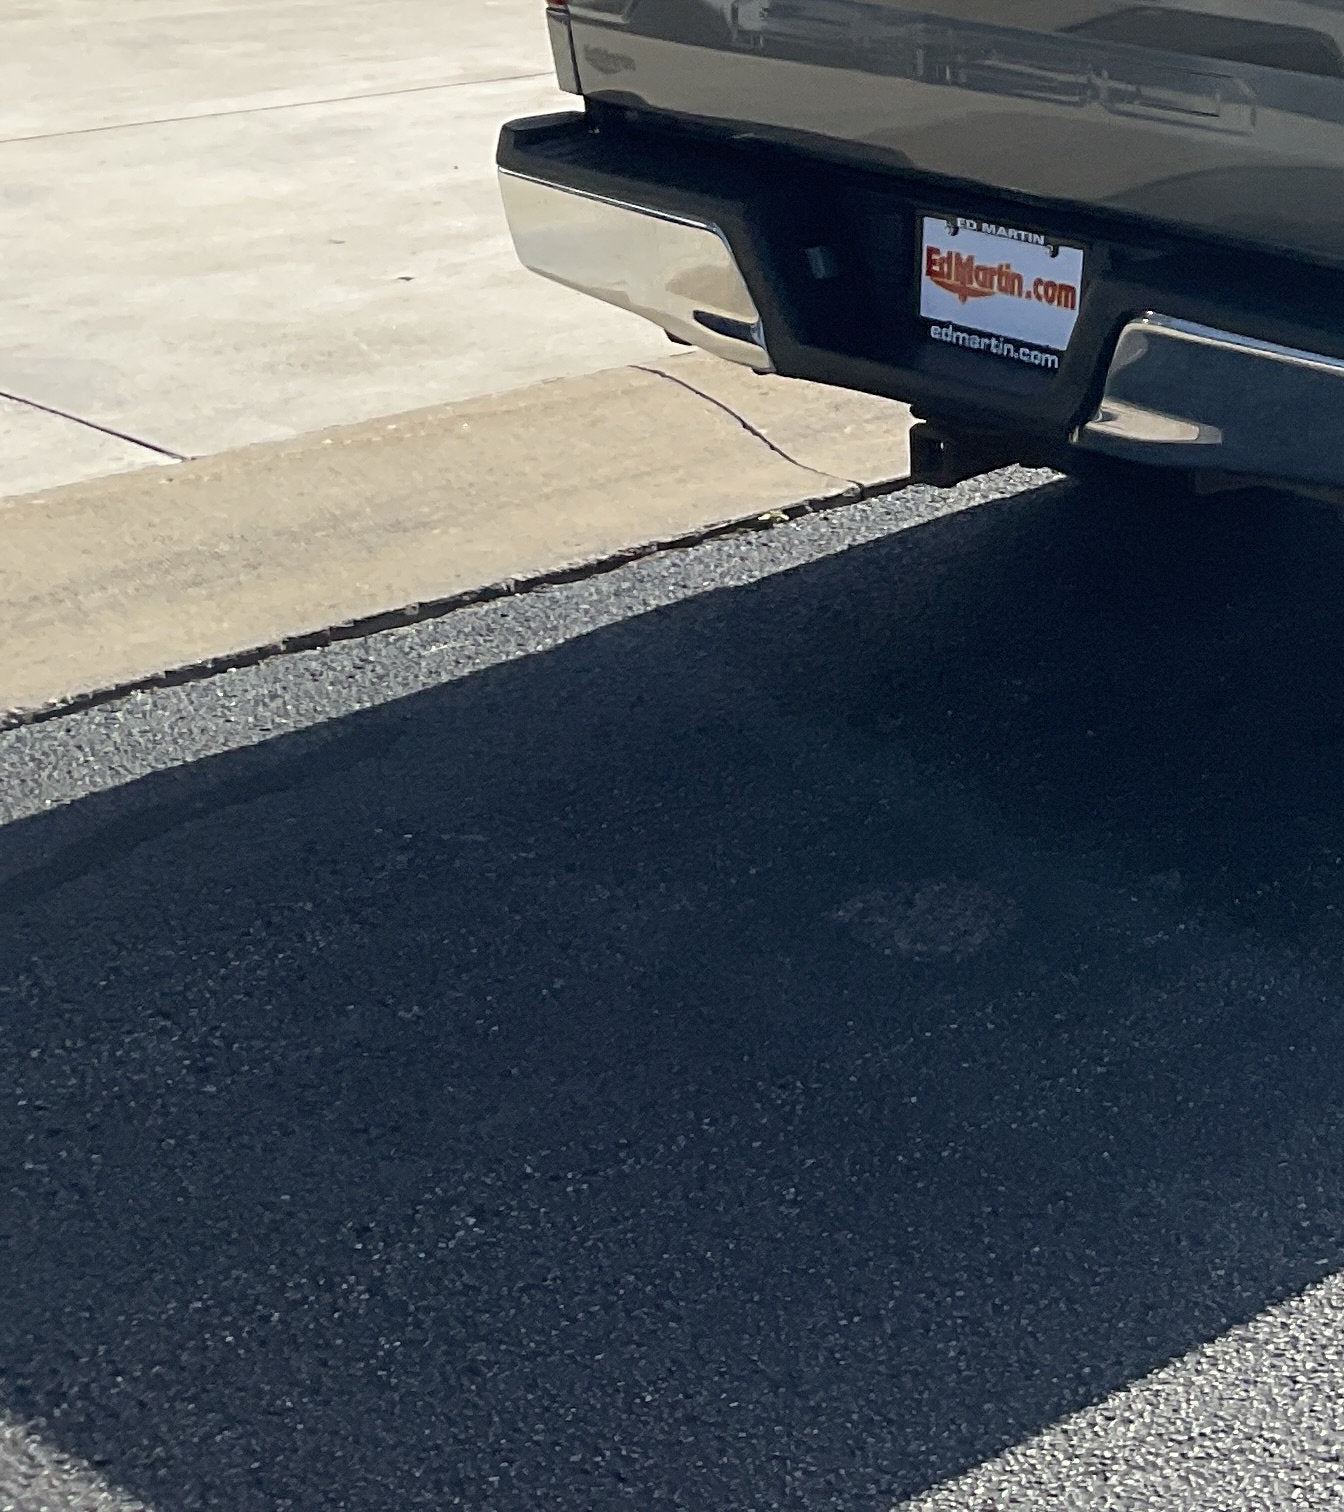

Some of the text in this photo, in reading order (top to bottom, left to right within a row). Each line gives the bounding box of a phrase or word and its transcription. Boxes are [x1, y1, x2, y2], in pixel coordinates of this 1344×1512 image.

[956, 218, 1046, 246] ED MARTIN
[925, 245, 1077, 311] EdMartin.com
[930, 323, 1060, 369] edmartin.com
